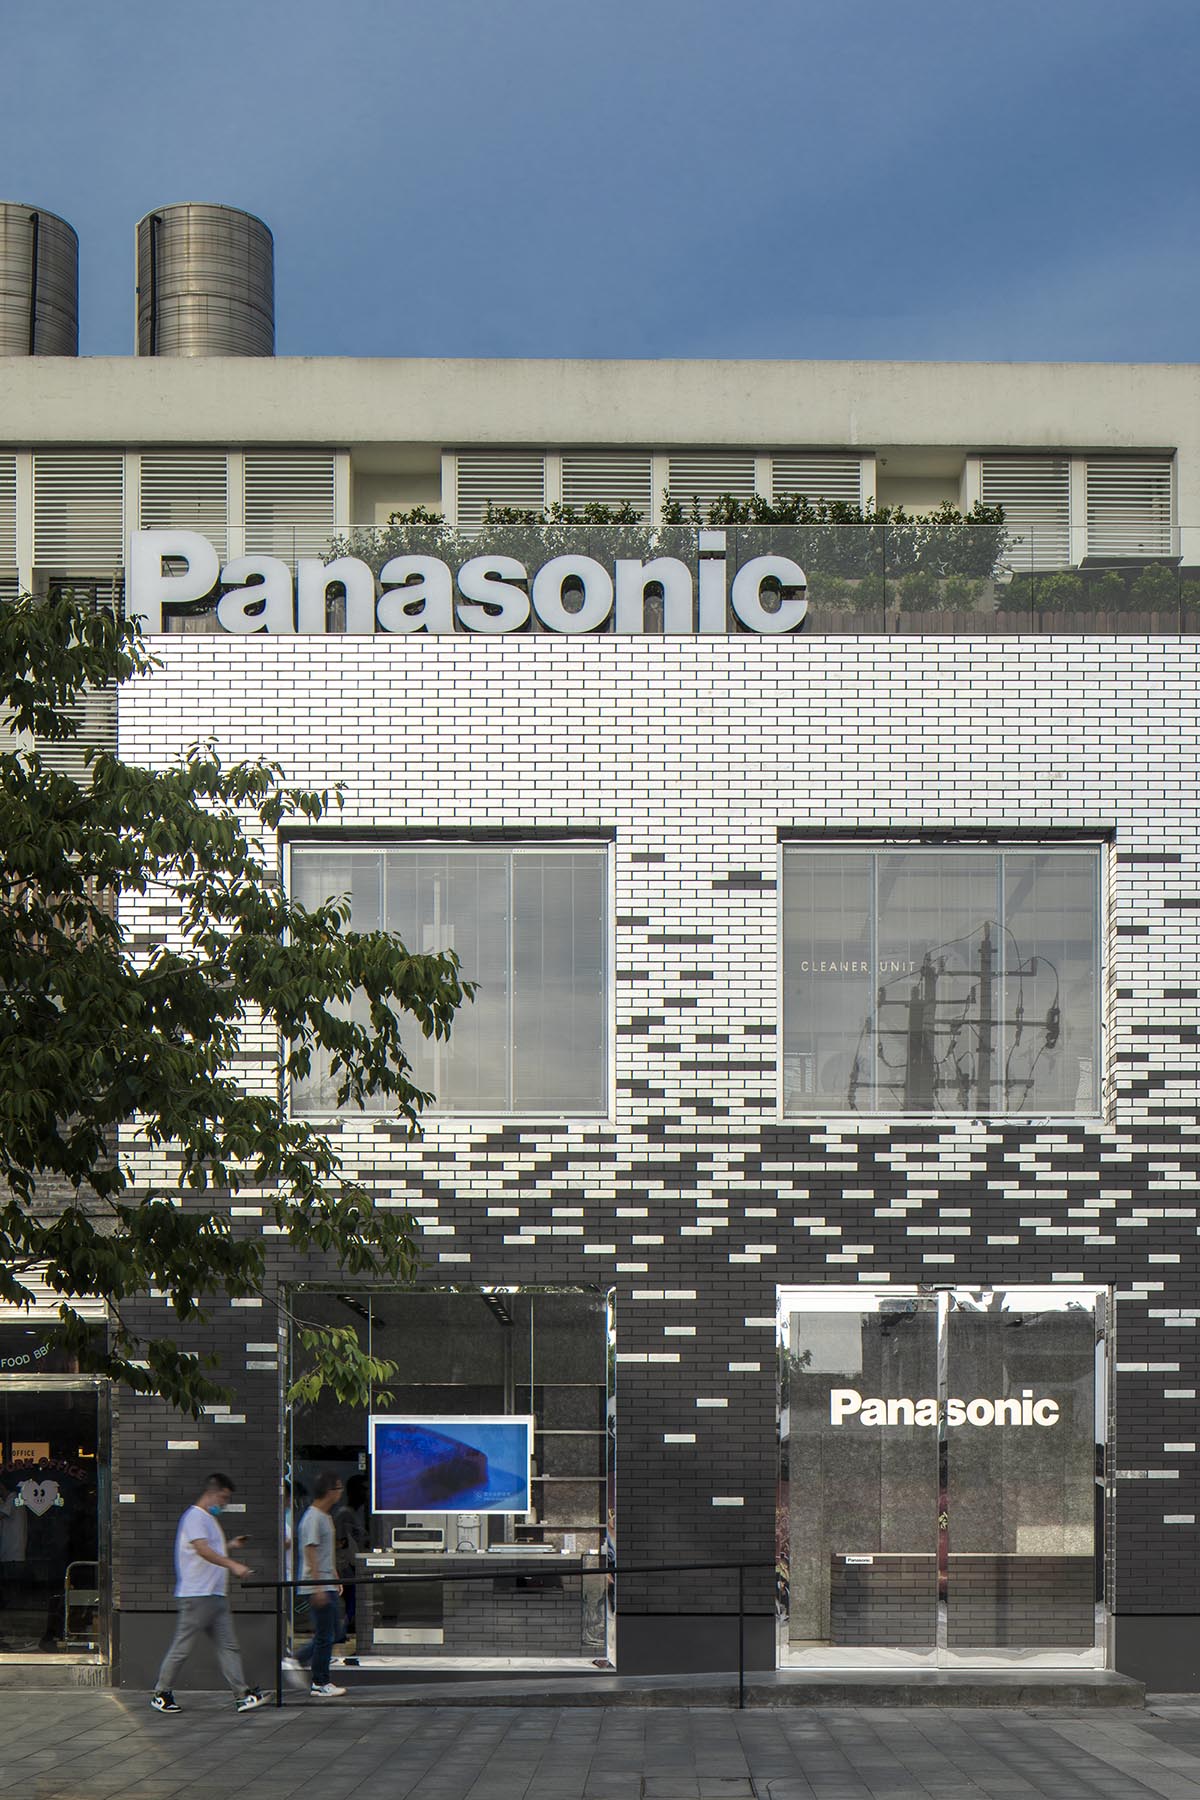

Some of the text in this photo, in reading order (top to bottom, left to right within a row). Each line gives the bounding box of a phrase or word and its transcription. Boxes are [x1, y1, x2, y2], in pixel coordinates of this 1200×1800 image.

[130, 529, 808, 634] Panasonic
[801, 961, 915, 972] CLEANER UNIT
[1, 1354, 30, 1368] FOOD
[830, 1388, 1060, 1426] Panasonic
